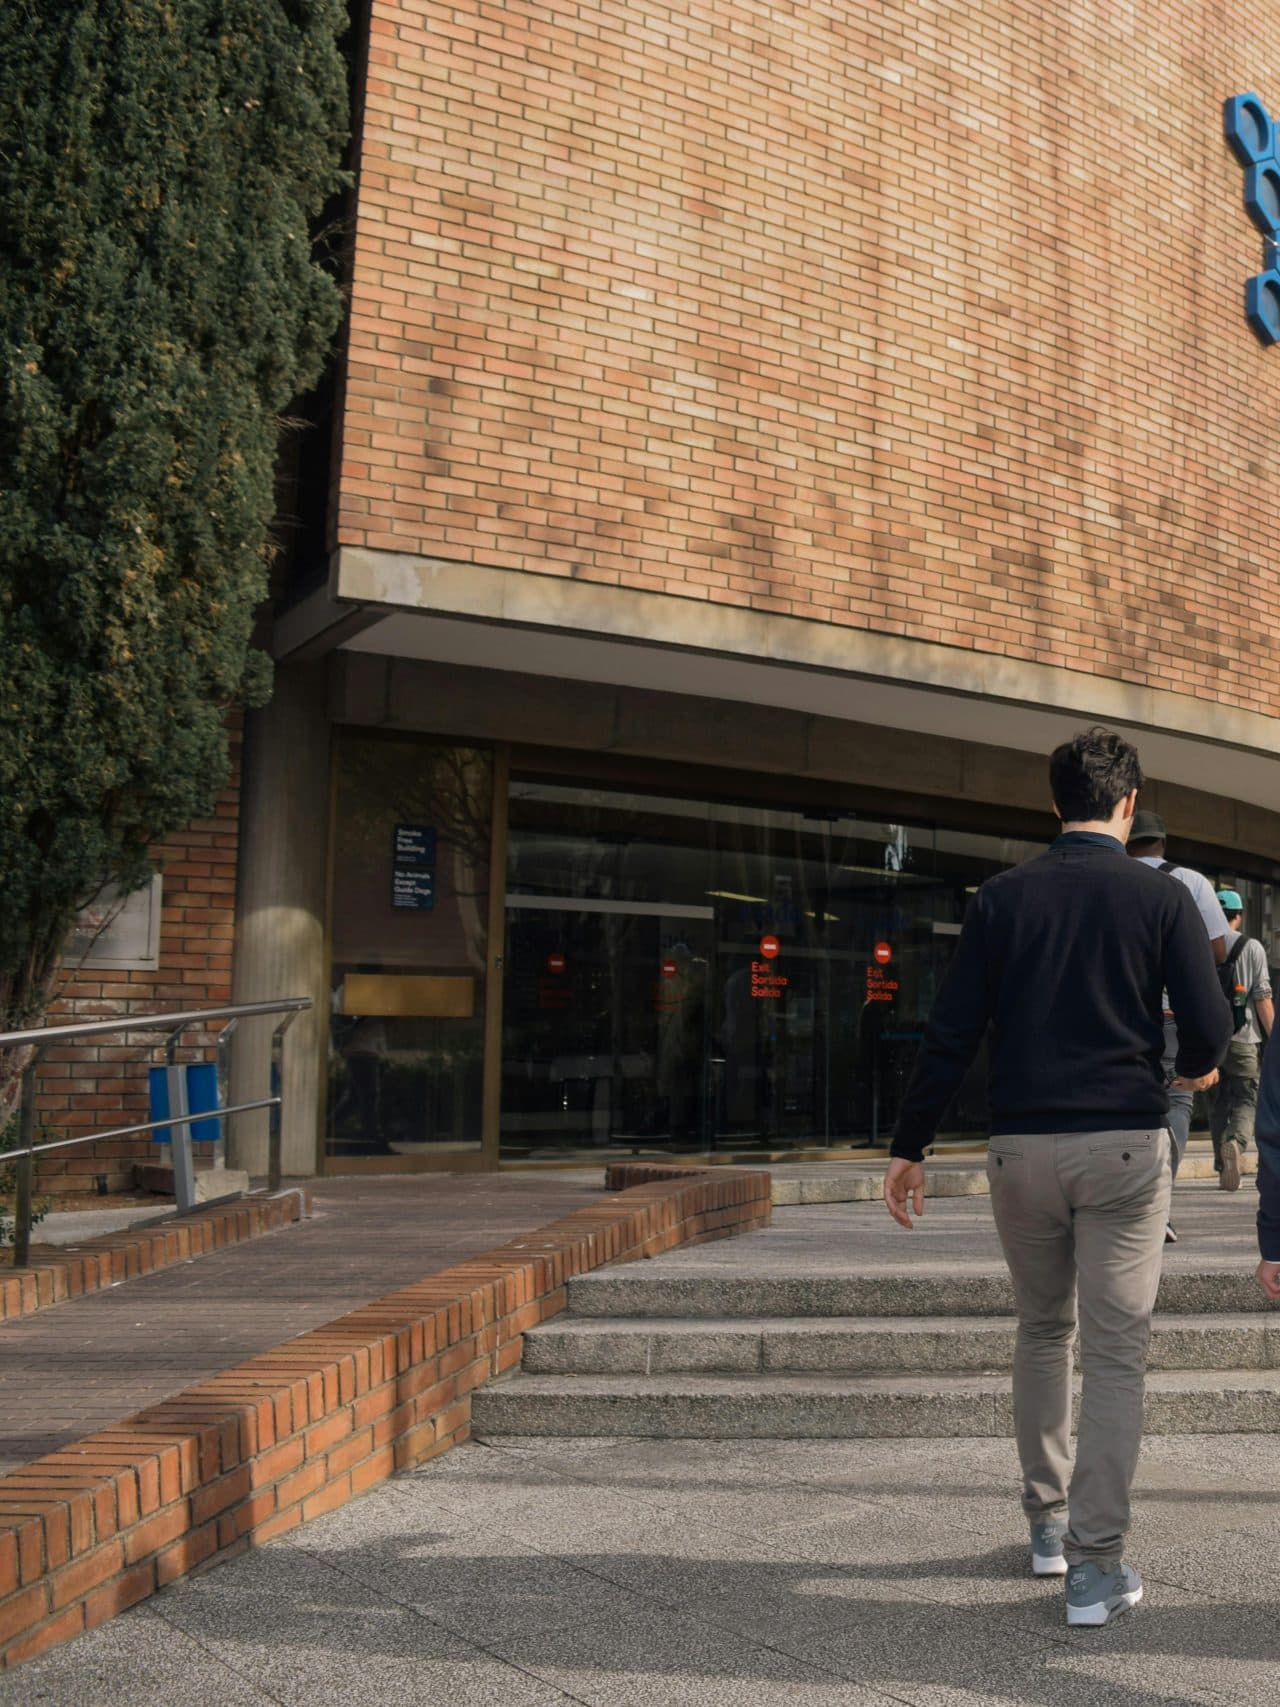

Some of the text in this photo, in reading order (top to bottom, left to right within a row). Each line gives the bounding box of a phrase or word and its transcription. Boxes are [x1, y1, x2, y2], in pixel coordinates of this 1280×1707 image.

[397, 844, 426, 854] Building
[752, 974, 788, 985] Sortida
[867, 979, 898, 990] Sortida
[752, 986, 781, 997] Salida
[867, 990, 892, 1000] Salida
